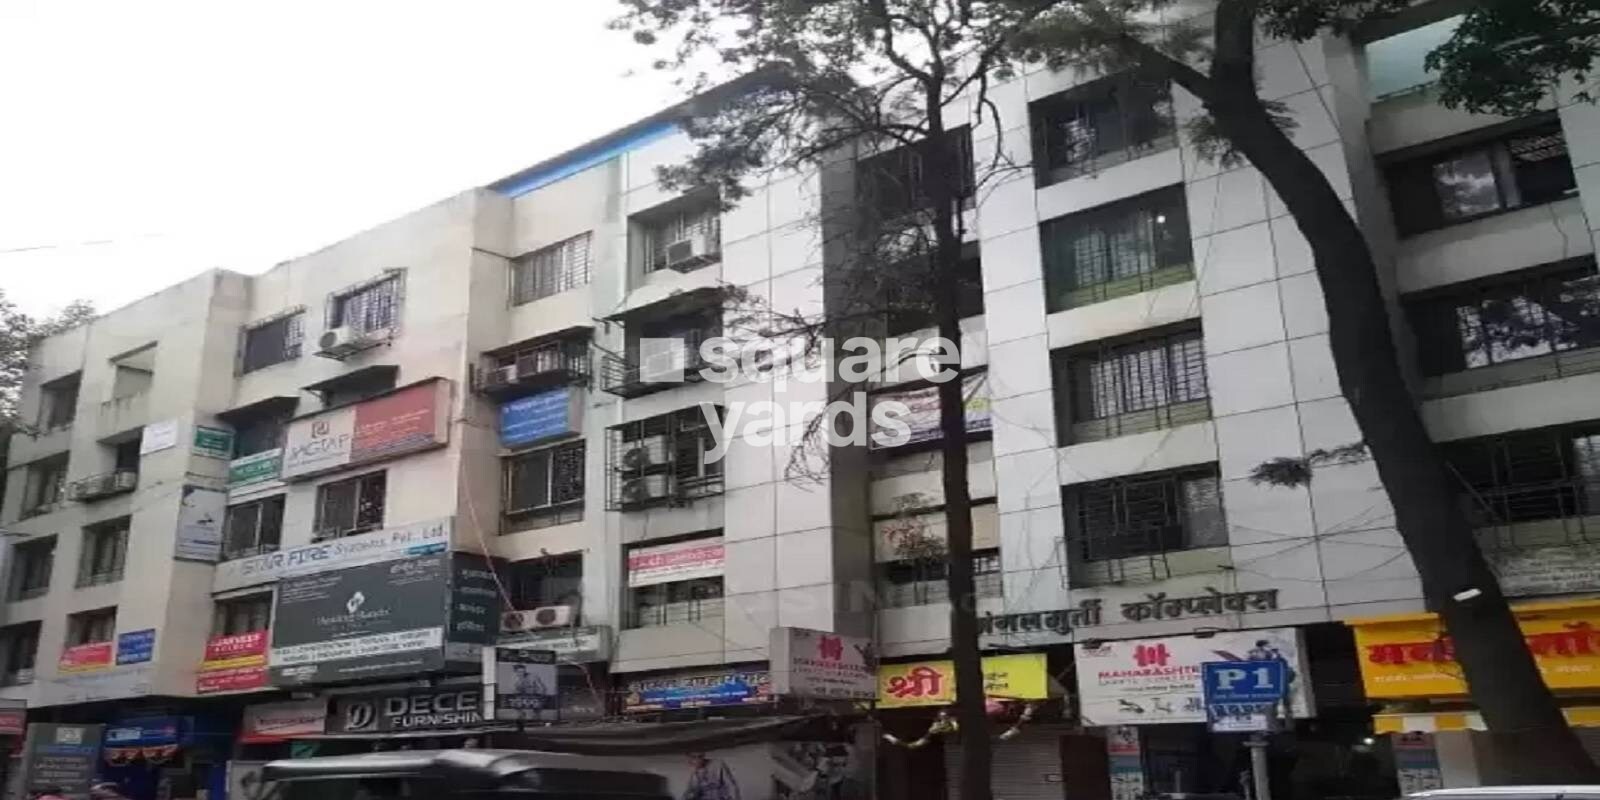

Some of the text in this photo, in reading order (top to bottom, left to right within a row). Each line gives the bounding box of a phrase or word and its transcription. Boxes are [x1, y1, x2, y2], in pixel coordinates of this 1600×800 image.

[287, 545, 331, 566] FIRE
[885, 666, 944, 698] श्री
[1098, 665, 1200, 679] MAHARASHTR
[386, 691, 477, 716] DECE
[391, 711, 482, 728] FURNISHIN
